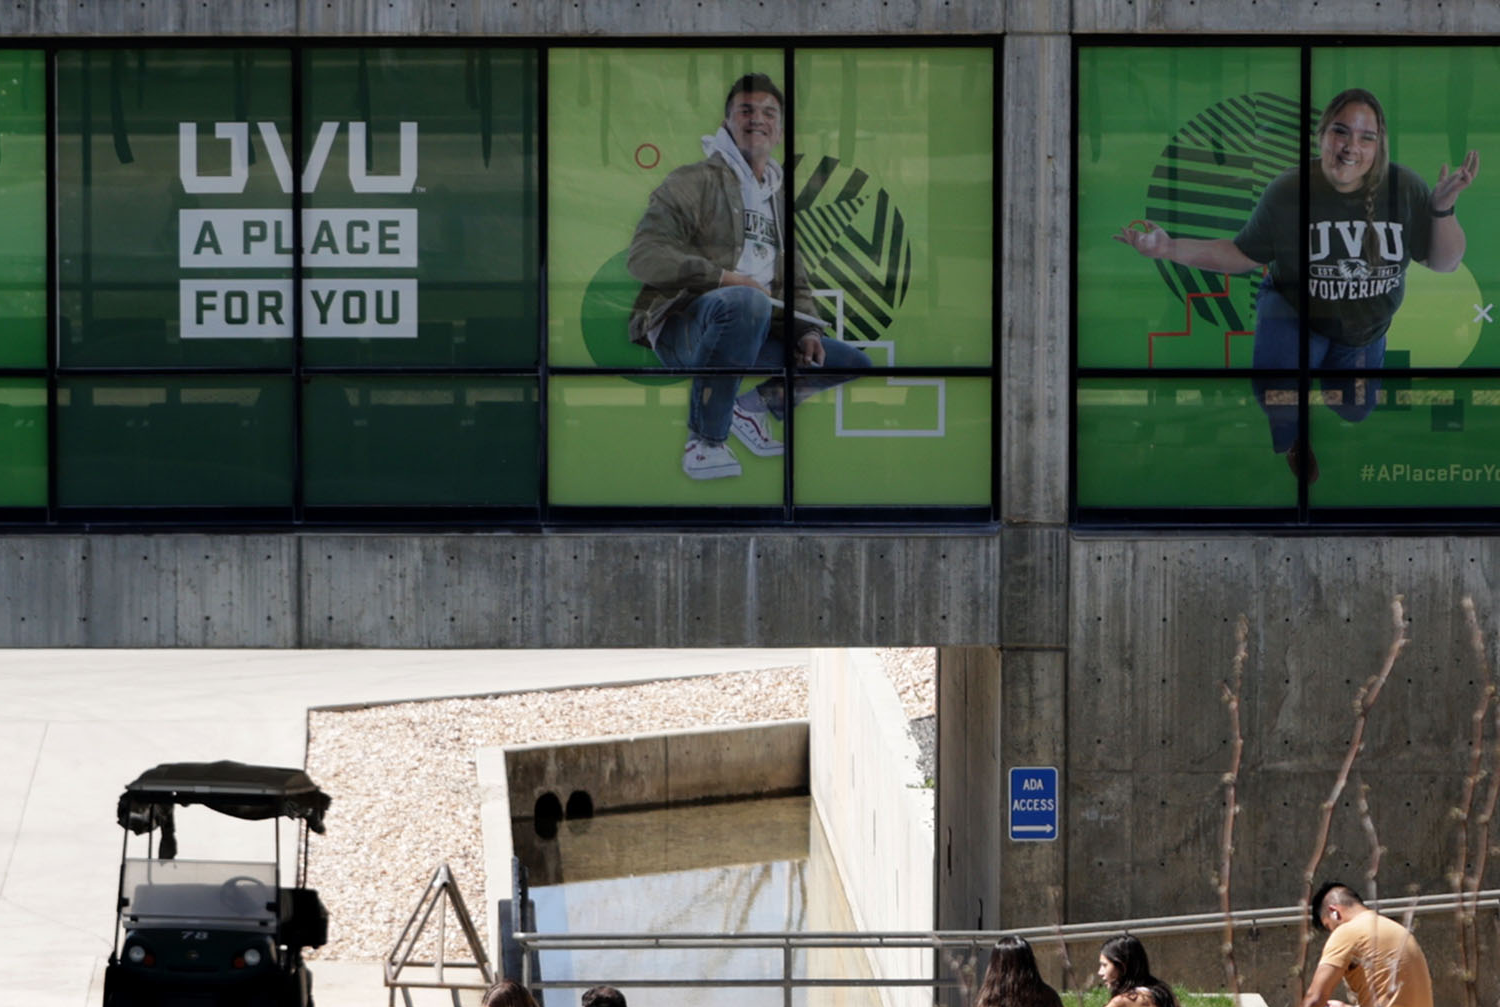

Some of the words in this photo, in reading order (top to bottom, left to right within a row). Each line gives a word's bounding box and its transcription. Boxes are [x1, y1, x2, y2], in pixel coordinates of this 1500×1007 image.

[179, 121, 418, 193] UVU
[193, 220, 222, 255] A
[243, 220, 400, 255] PLACE
[1308, 220, 1404, 262] UVU
[195, 290, 285, 325] FOR
[310, 290, 400, 325] YOU
[1023, 779, 1044, 790] ADA
[1013, 799, 1055, 811] ACCESS
